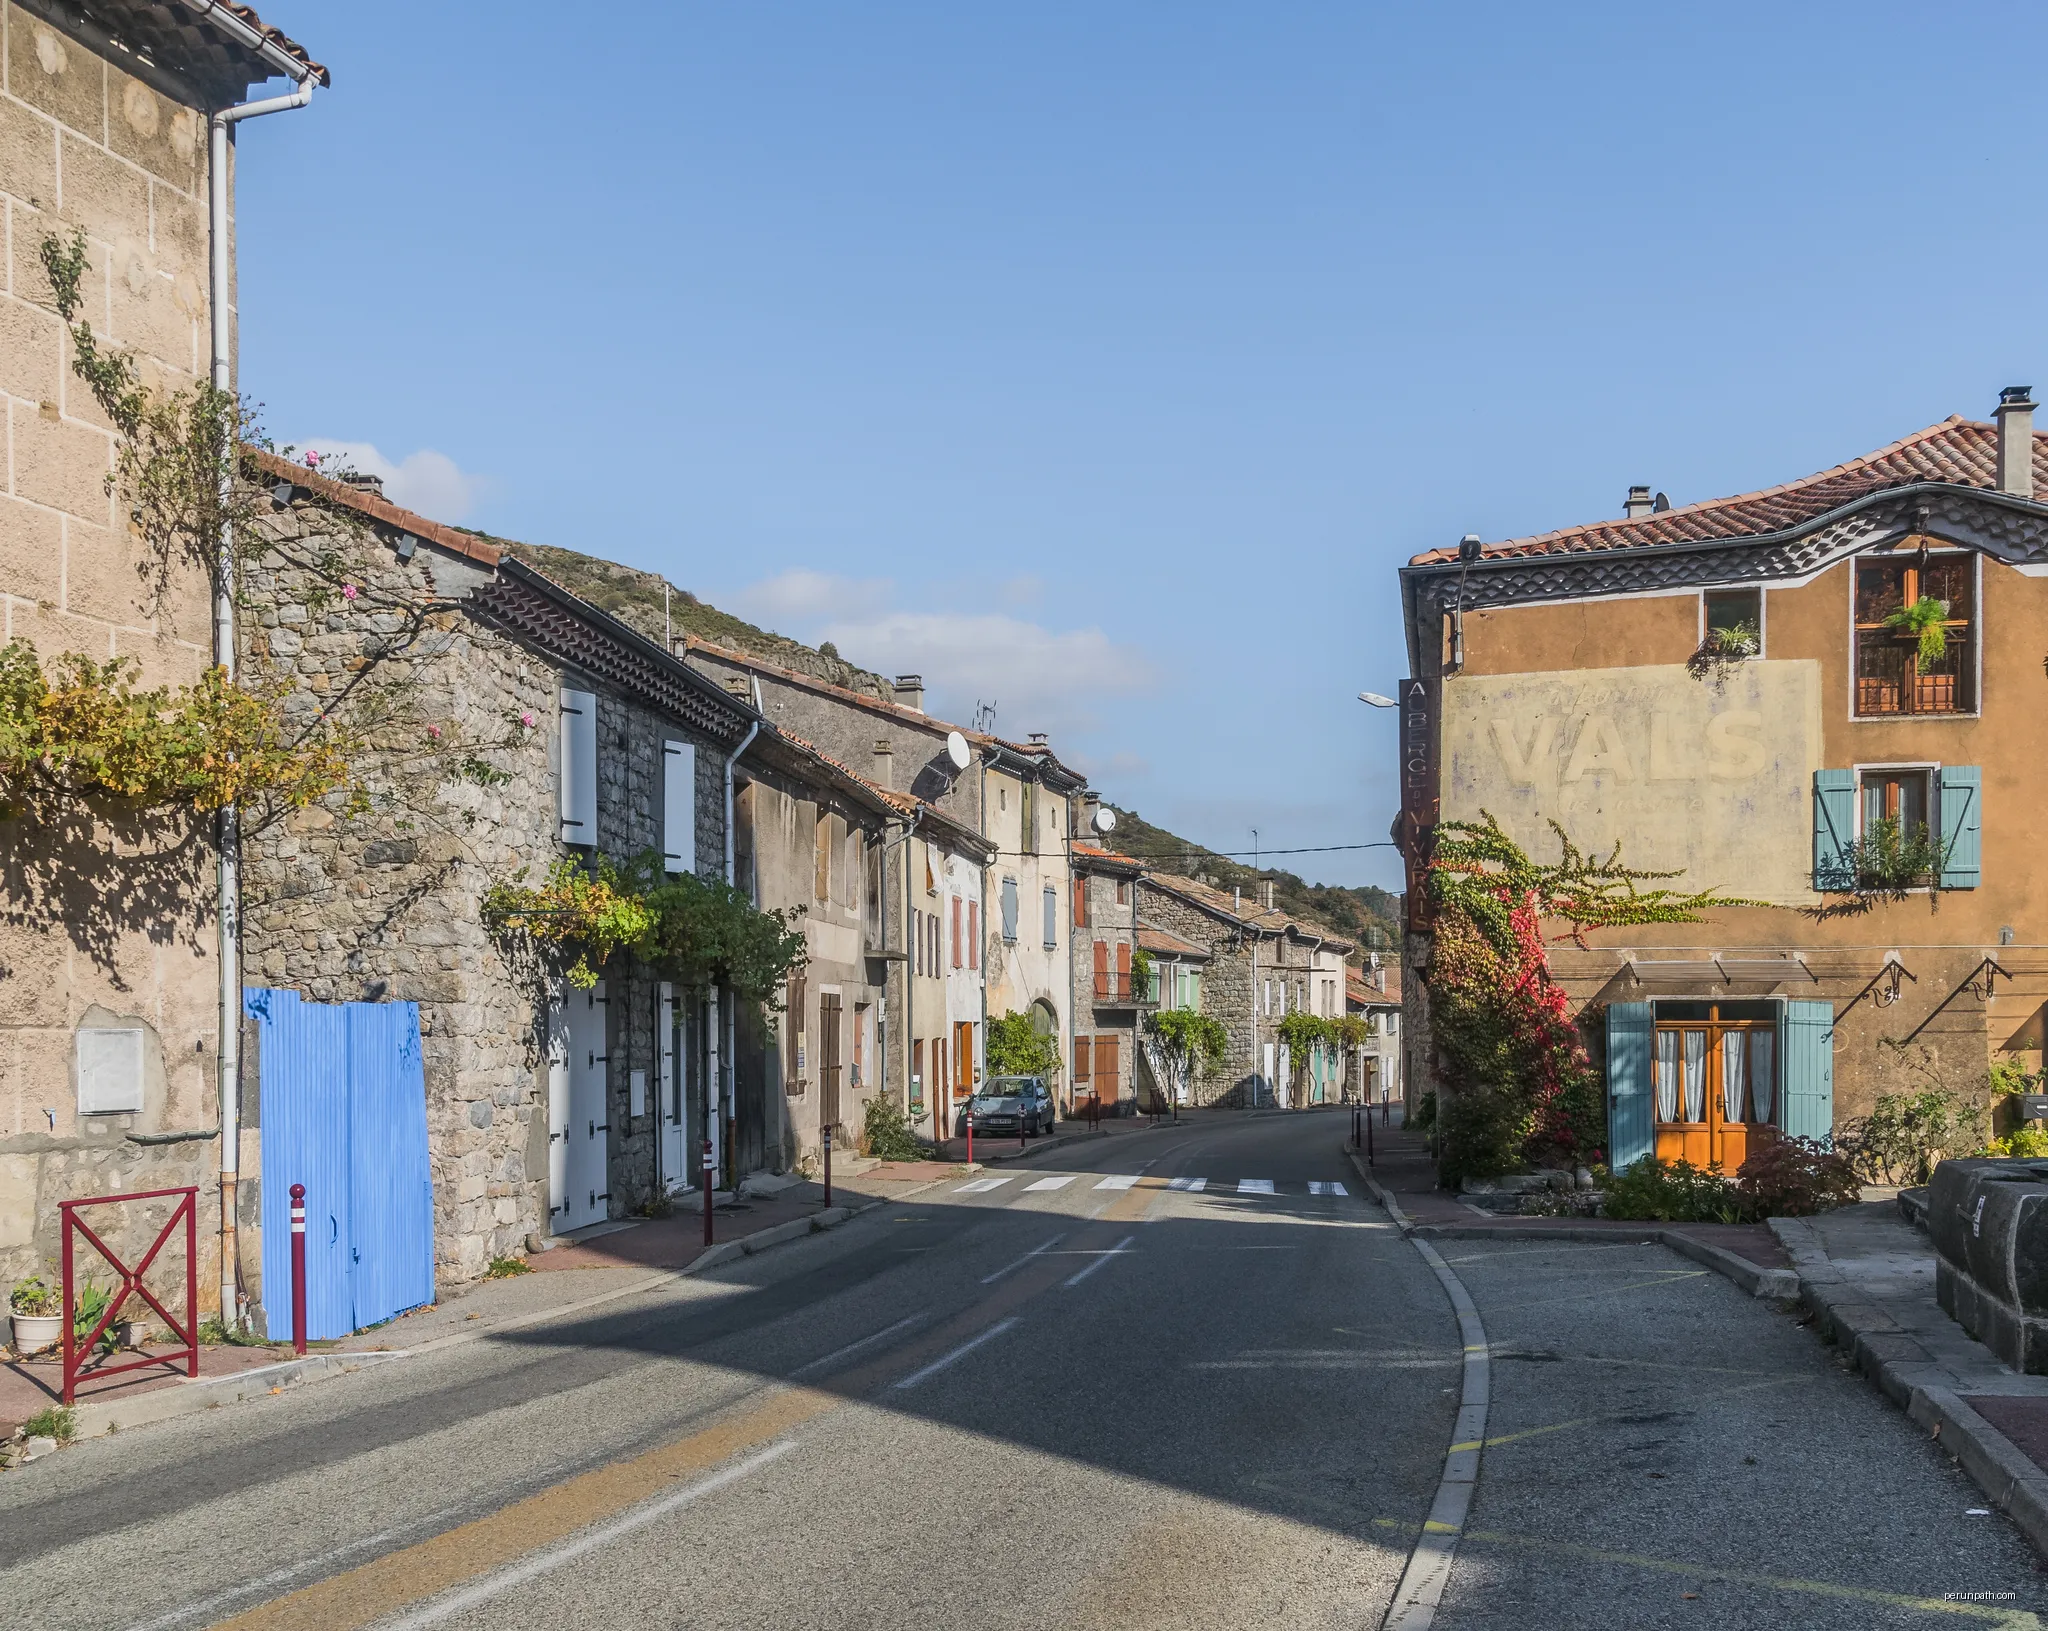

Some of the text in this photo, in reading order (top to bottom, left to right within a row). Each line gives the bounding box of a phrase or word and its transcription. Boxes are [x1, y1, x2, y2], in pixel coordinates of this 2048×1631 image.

[1408, 681, 1428, 789] AUBERGE
[1488, 710, 1766, 786] VALS
[1408, 809, 1429, 929] VIVARAIS
